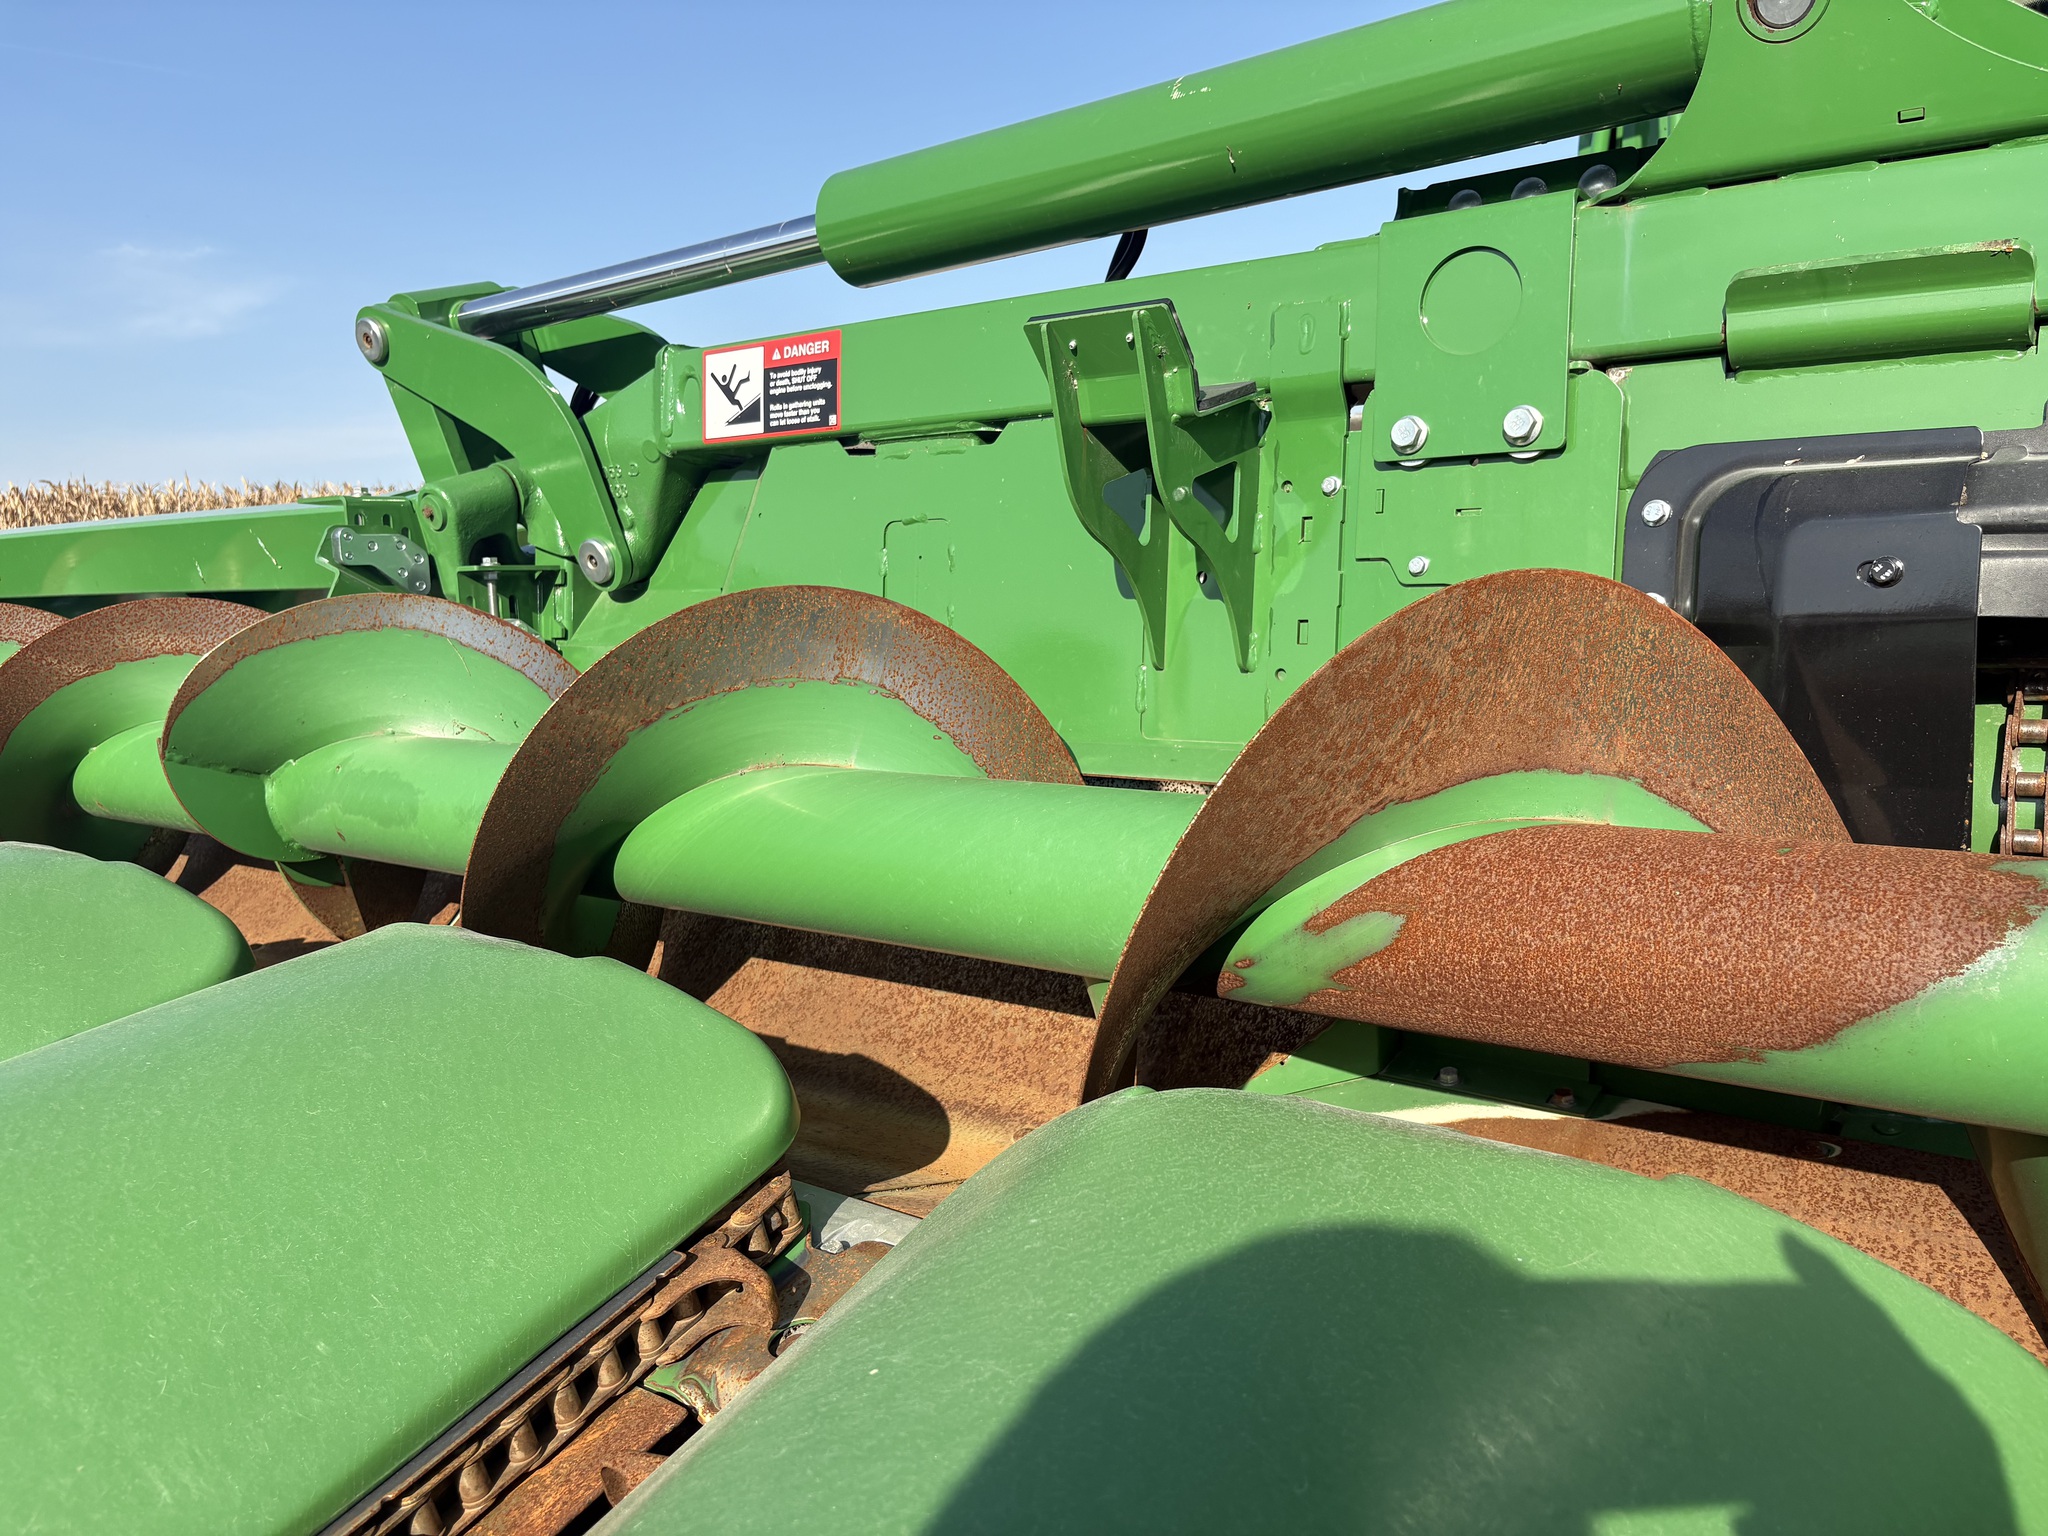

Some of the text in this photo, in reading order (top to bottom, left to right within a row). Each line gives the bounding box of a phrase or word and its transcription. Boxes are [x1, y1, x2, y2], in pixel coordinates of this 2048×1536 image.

[783, 339, 830, 359] DANGER
[777, 370, 791, 379] avoid
[791, 368, 807, 377] bodily
[791, 375, 806, 385] SHUT
[806, 374, 818, 383] OFF
[769, 387, 787, 396] engine
[786, 385, 803, 393] before
[788, 400, 813, 411] gathering
[812, 398, 826, 407] units
[798, 408, 810, 416] than
[810, 407, 821, 416] you
[786, 417, 801, 425] loose
